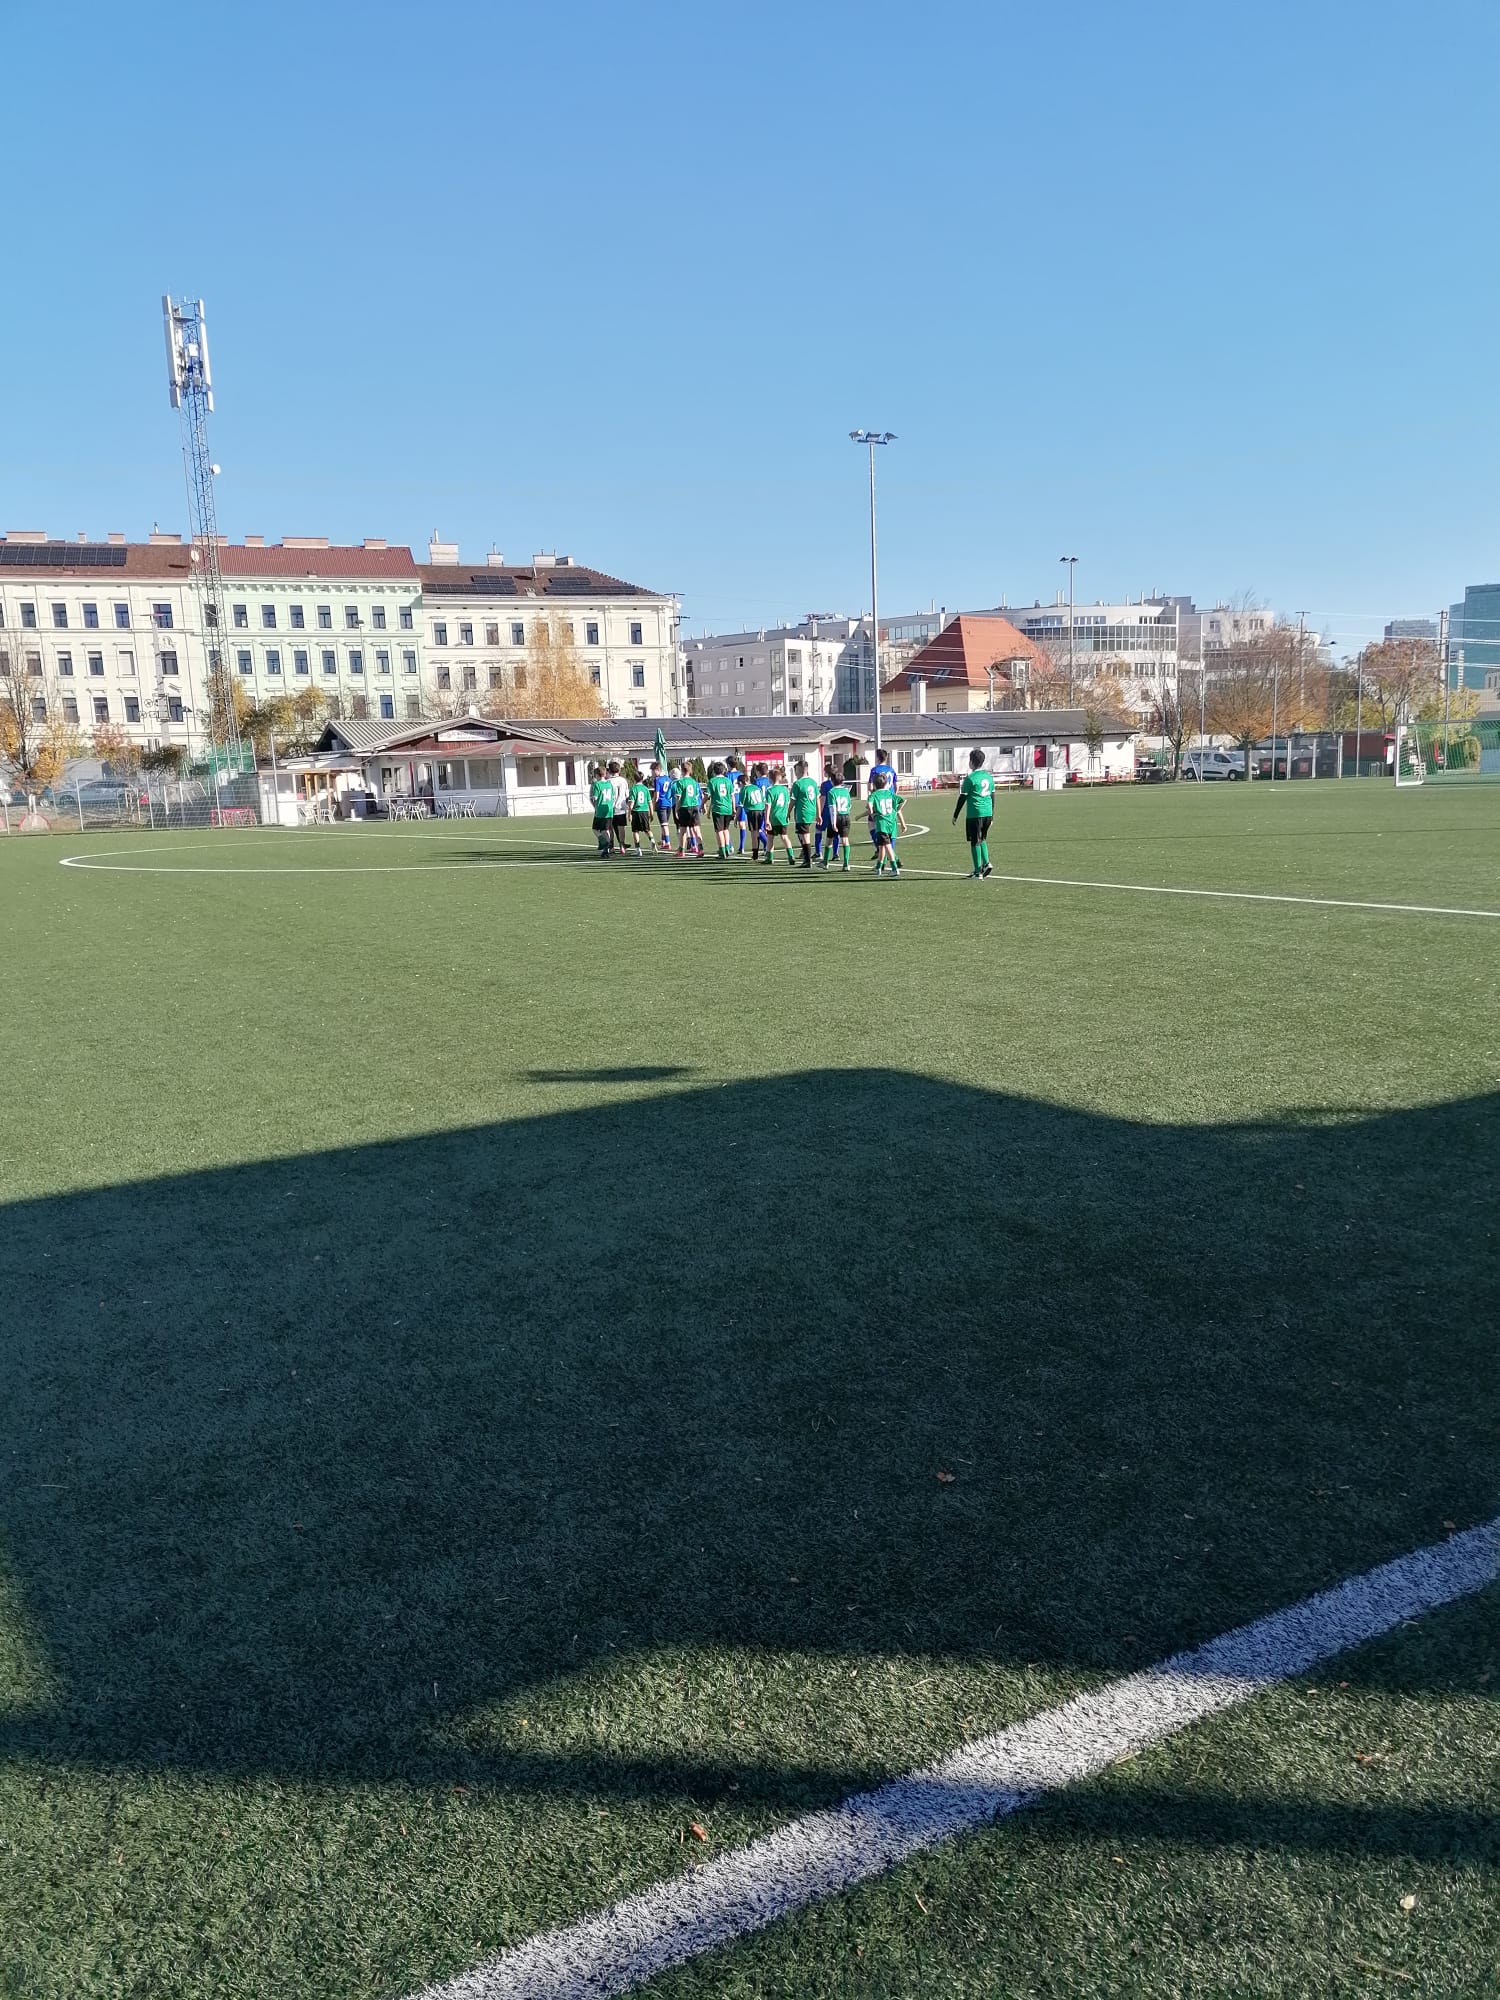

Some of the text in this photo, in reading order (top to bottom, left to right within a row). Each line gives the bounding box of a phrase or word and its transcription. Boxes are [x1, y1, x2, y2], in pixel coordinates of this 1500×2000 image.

[602, 788, 611, 801] 14
[687, 785, 694, 797] 9
[720, 784, 727, 797] 5
[807, 785, 815, 801] 3
[981, 779, 990, 796] 2
[776, 793, 784, 807] 4
[837, 796, 848, 811] 12
[880, 798, 892, 815] 15
